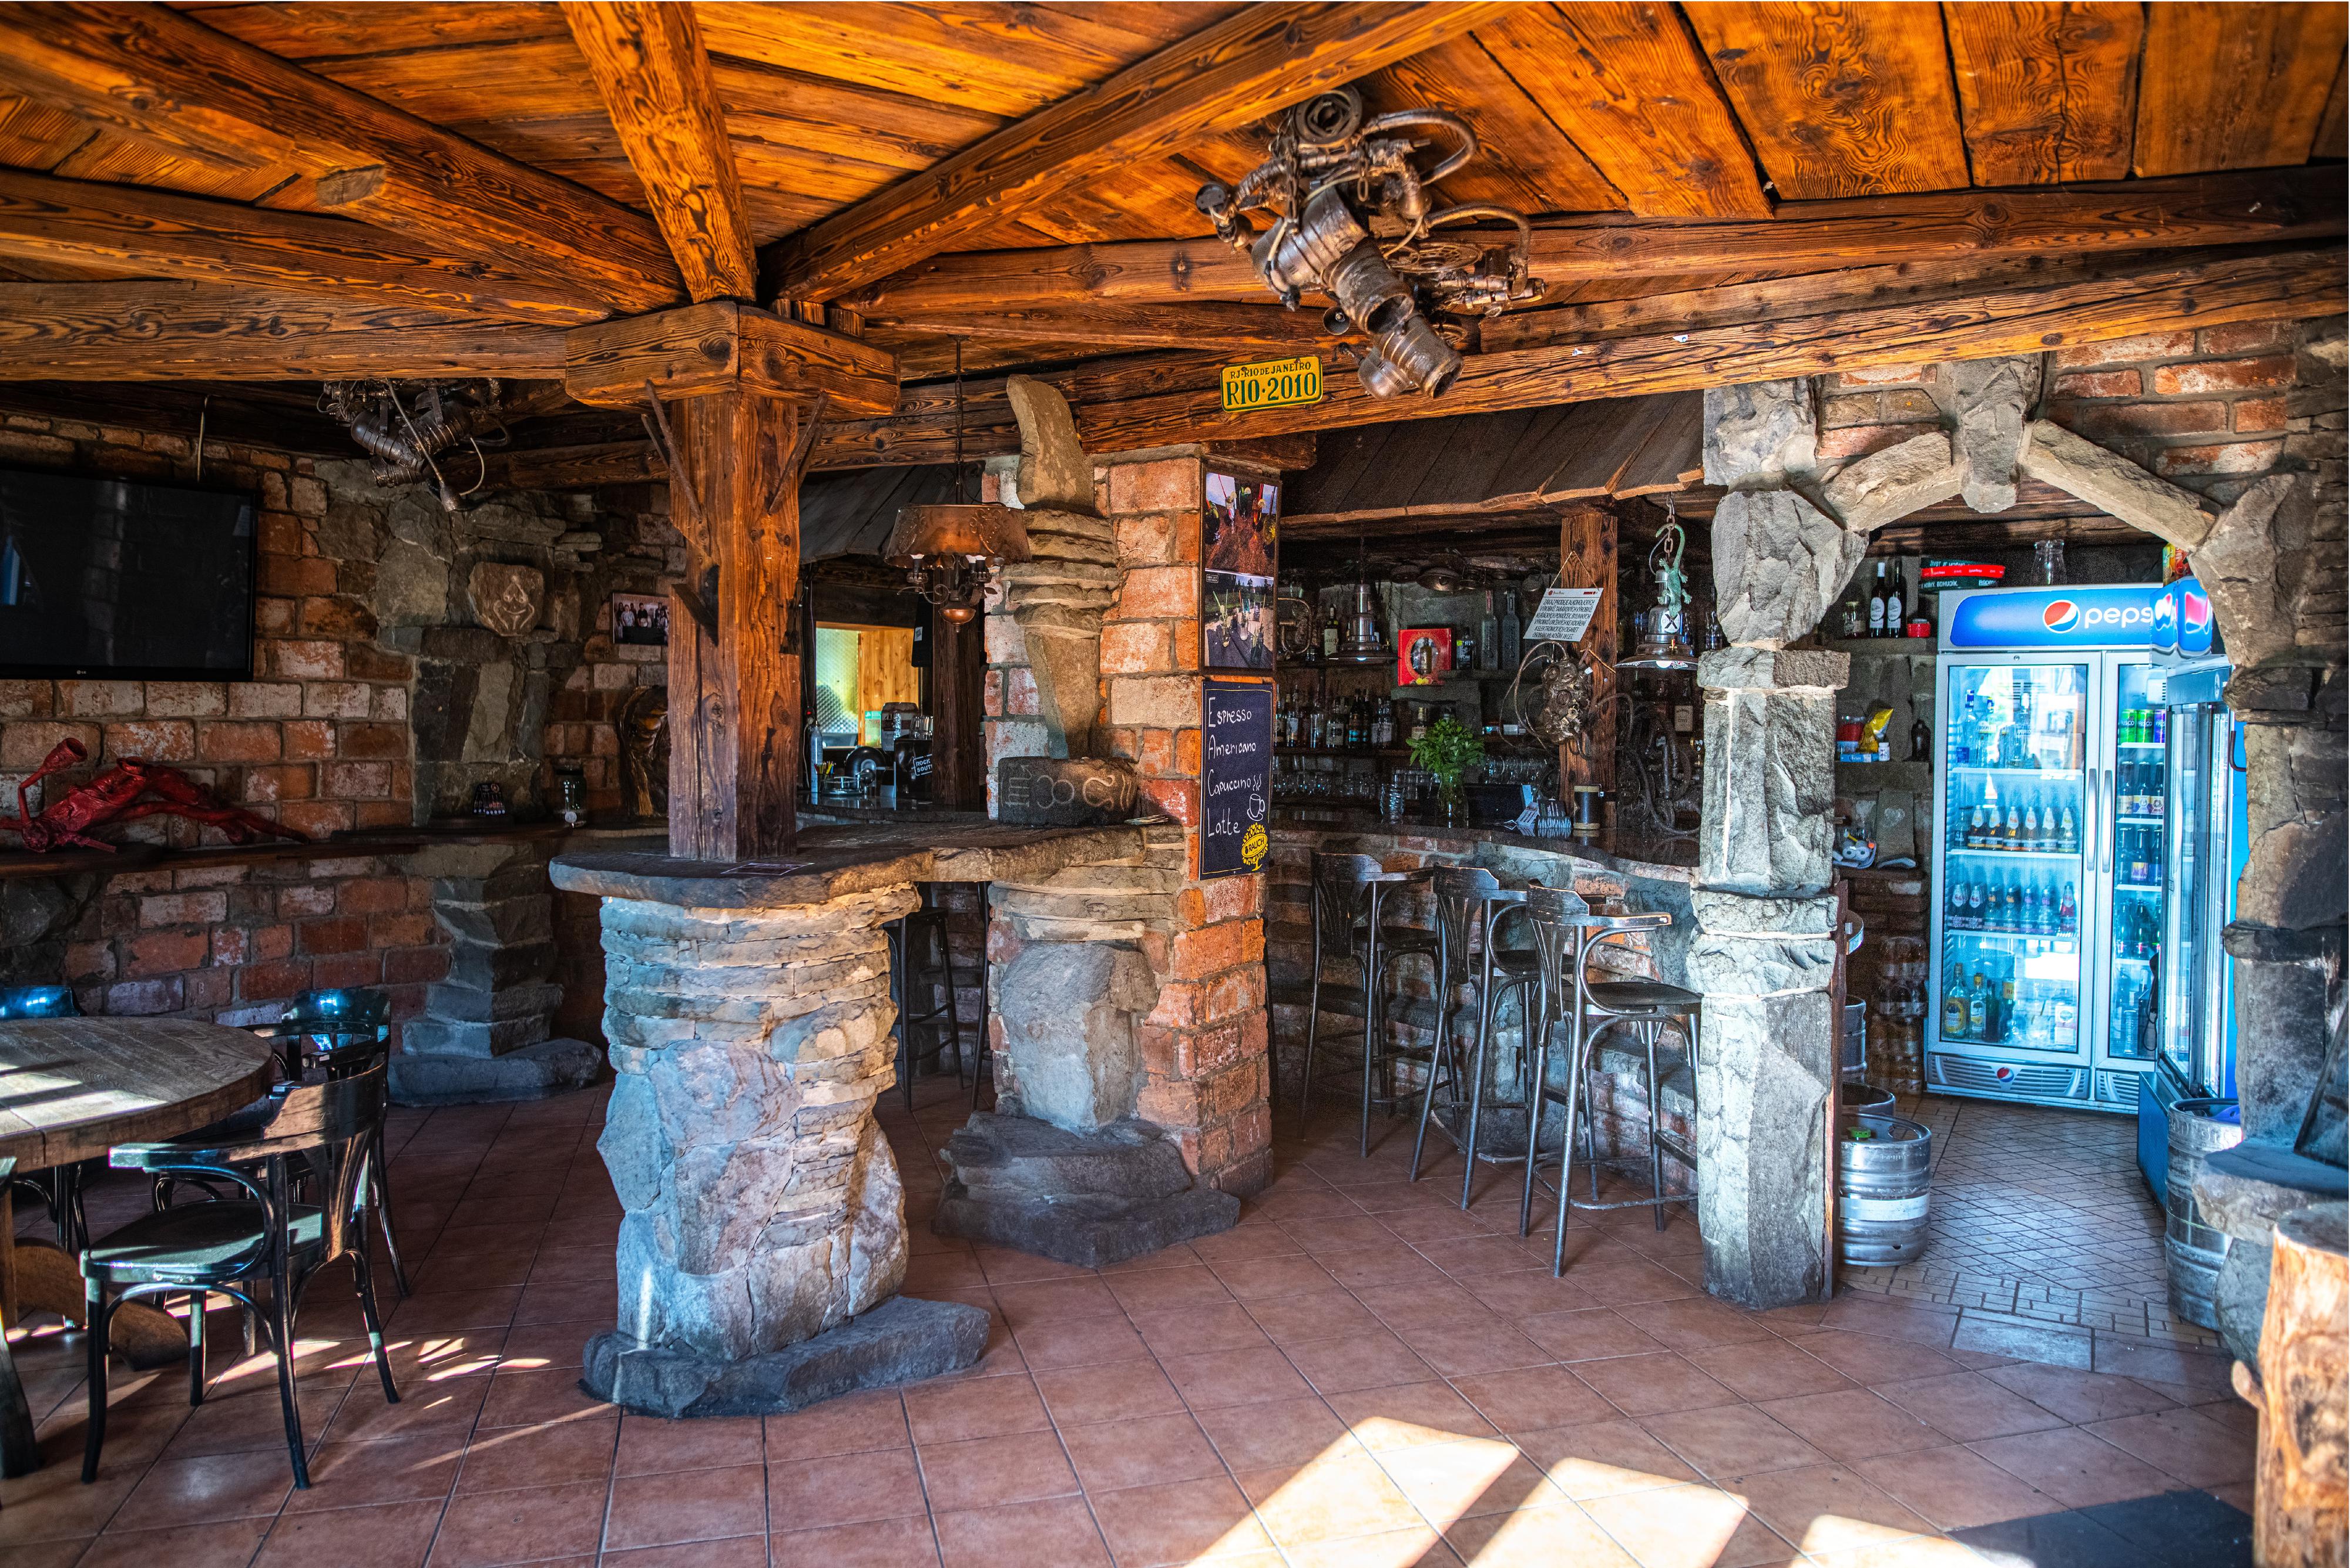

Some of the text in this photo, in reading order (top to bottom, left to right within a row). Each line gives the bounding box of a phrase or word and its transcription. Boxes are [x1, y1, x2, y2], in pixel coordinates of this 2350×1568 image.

[1260, 367, 1270, 375] DE
[1271, 361, 1311, 374] JANEIRO
[2084, 607, 2153, 629] peps
[1208, 697, 1252, 728] Espresso
[1208, 734, 1256, 760] Americano
[917, 764, 932, 773] SOUT
[1207, 769, 1251, 797] Capuccino
[1207, 808, 1241, 838] Latte
[1248, 837, 1265, 852] RAUCH
